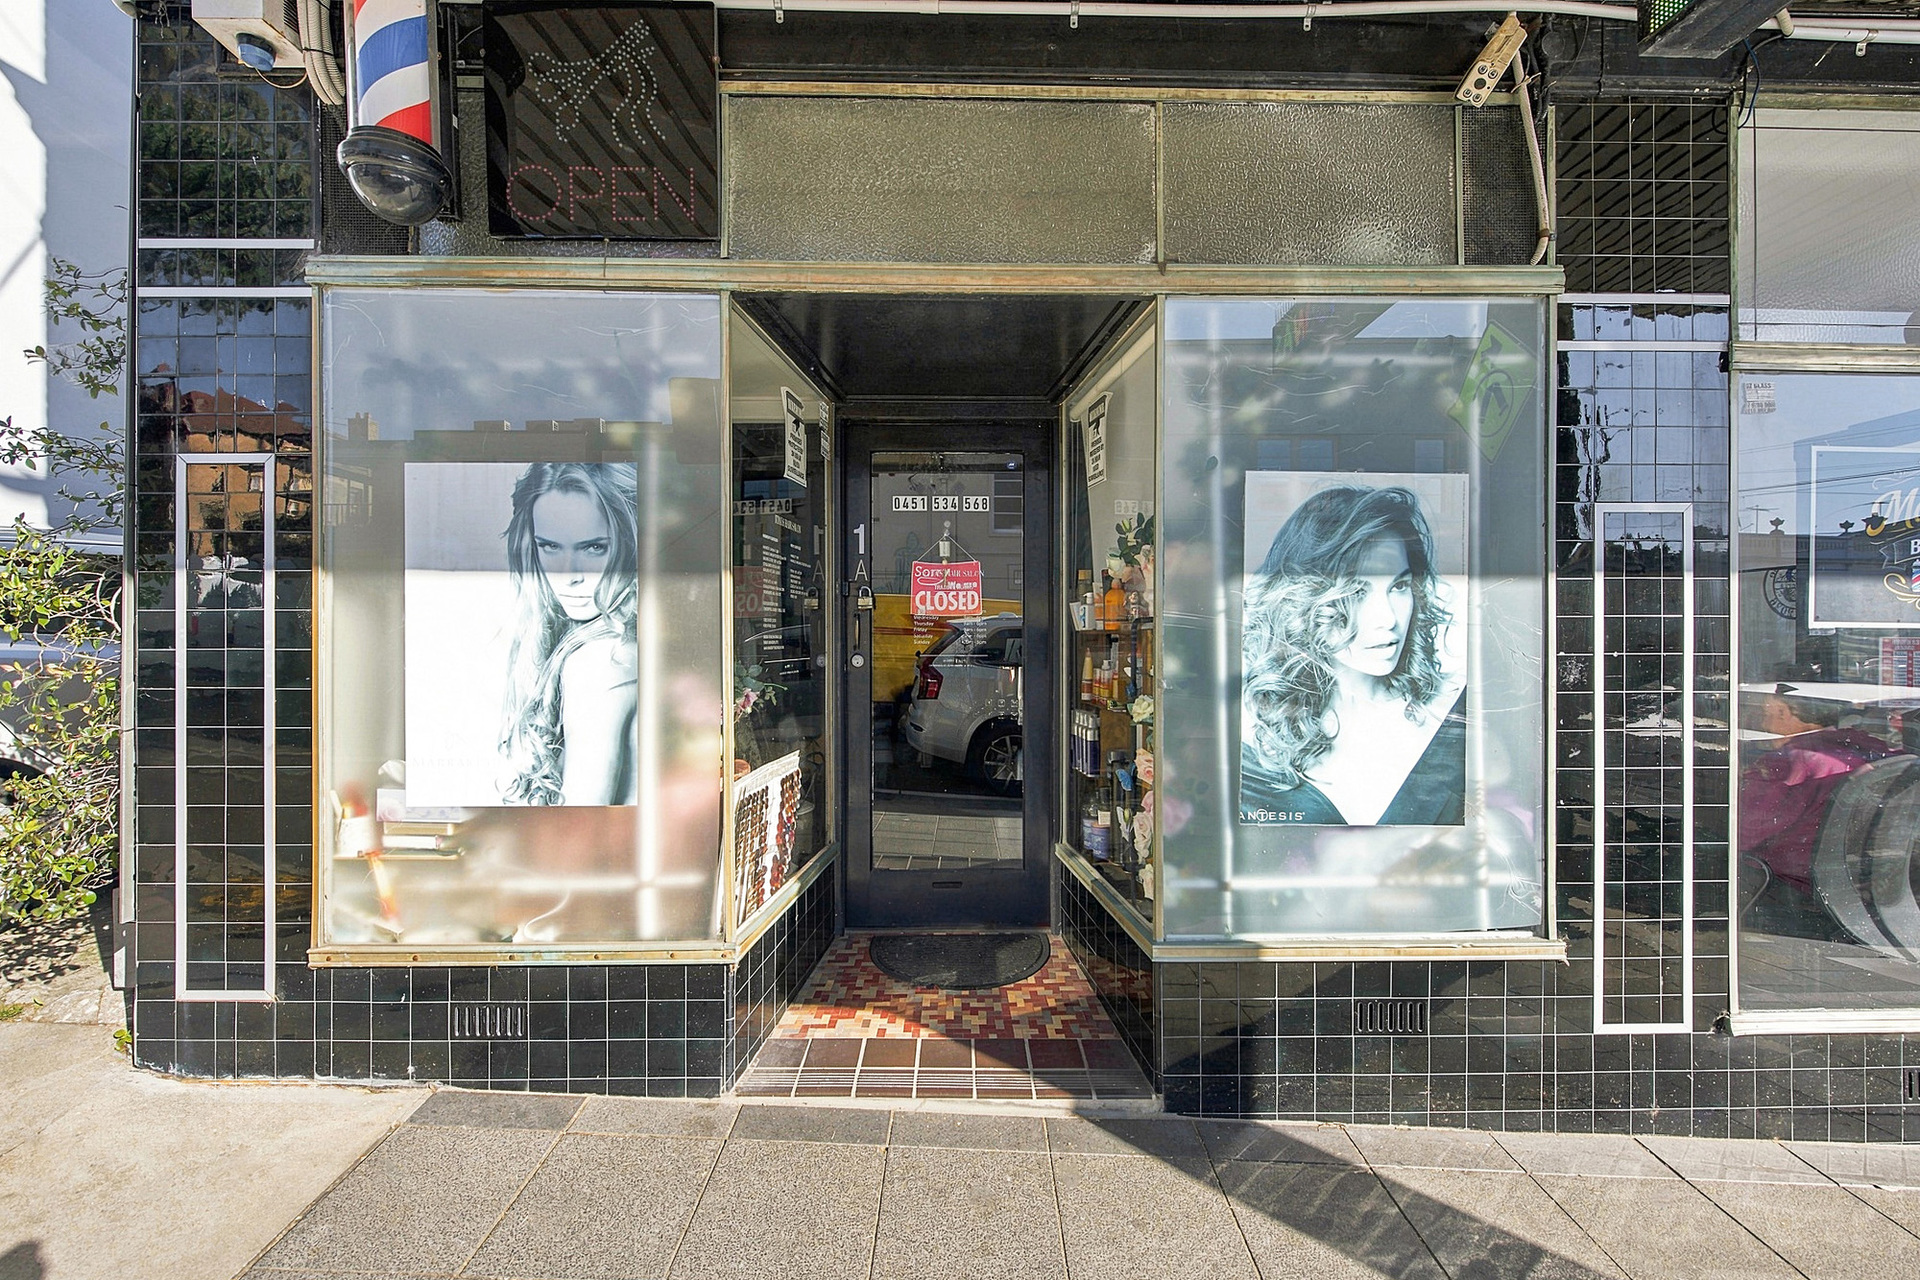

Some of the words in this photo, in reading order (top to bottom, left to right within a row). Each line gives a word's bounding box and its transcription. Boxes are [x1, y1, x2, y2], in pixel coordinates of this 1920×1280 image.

[507, 165, 696, 221] OPEN
[894, 497, 926, 510] 0451
[933, 497, 957, 510] 534
[964, 497, 988, 510] 568
[853, 524, 865, 555] 1
[854, 559, 868, 581] A
[915, 590, 979, 612] CLOSED
